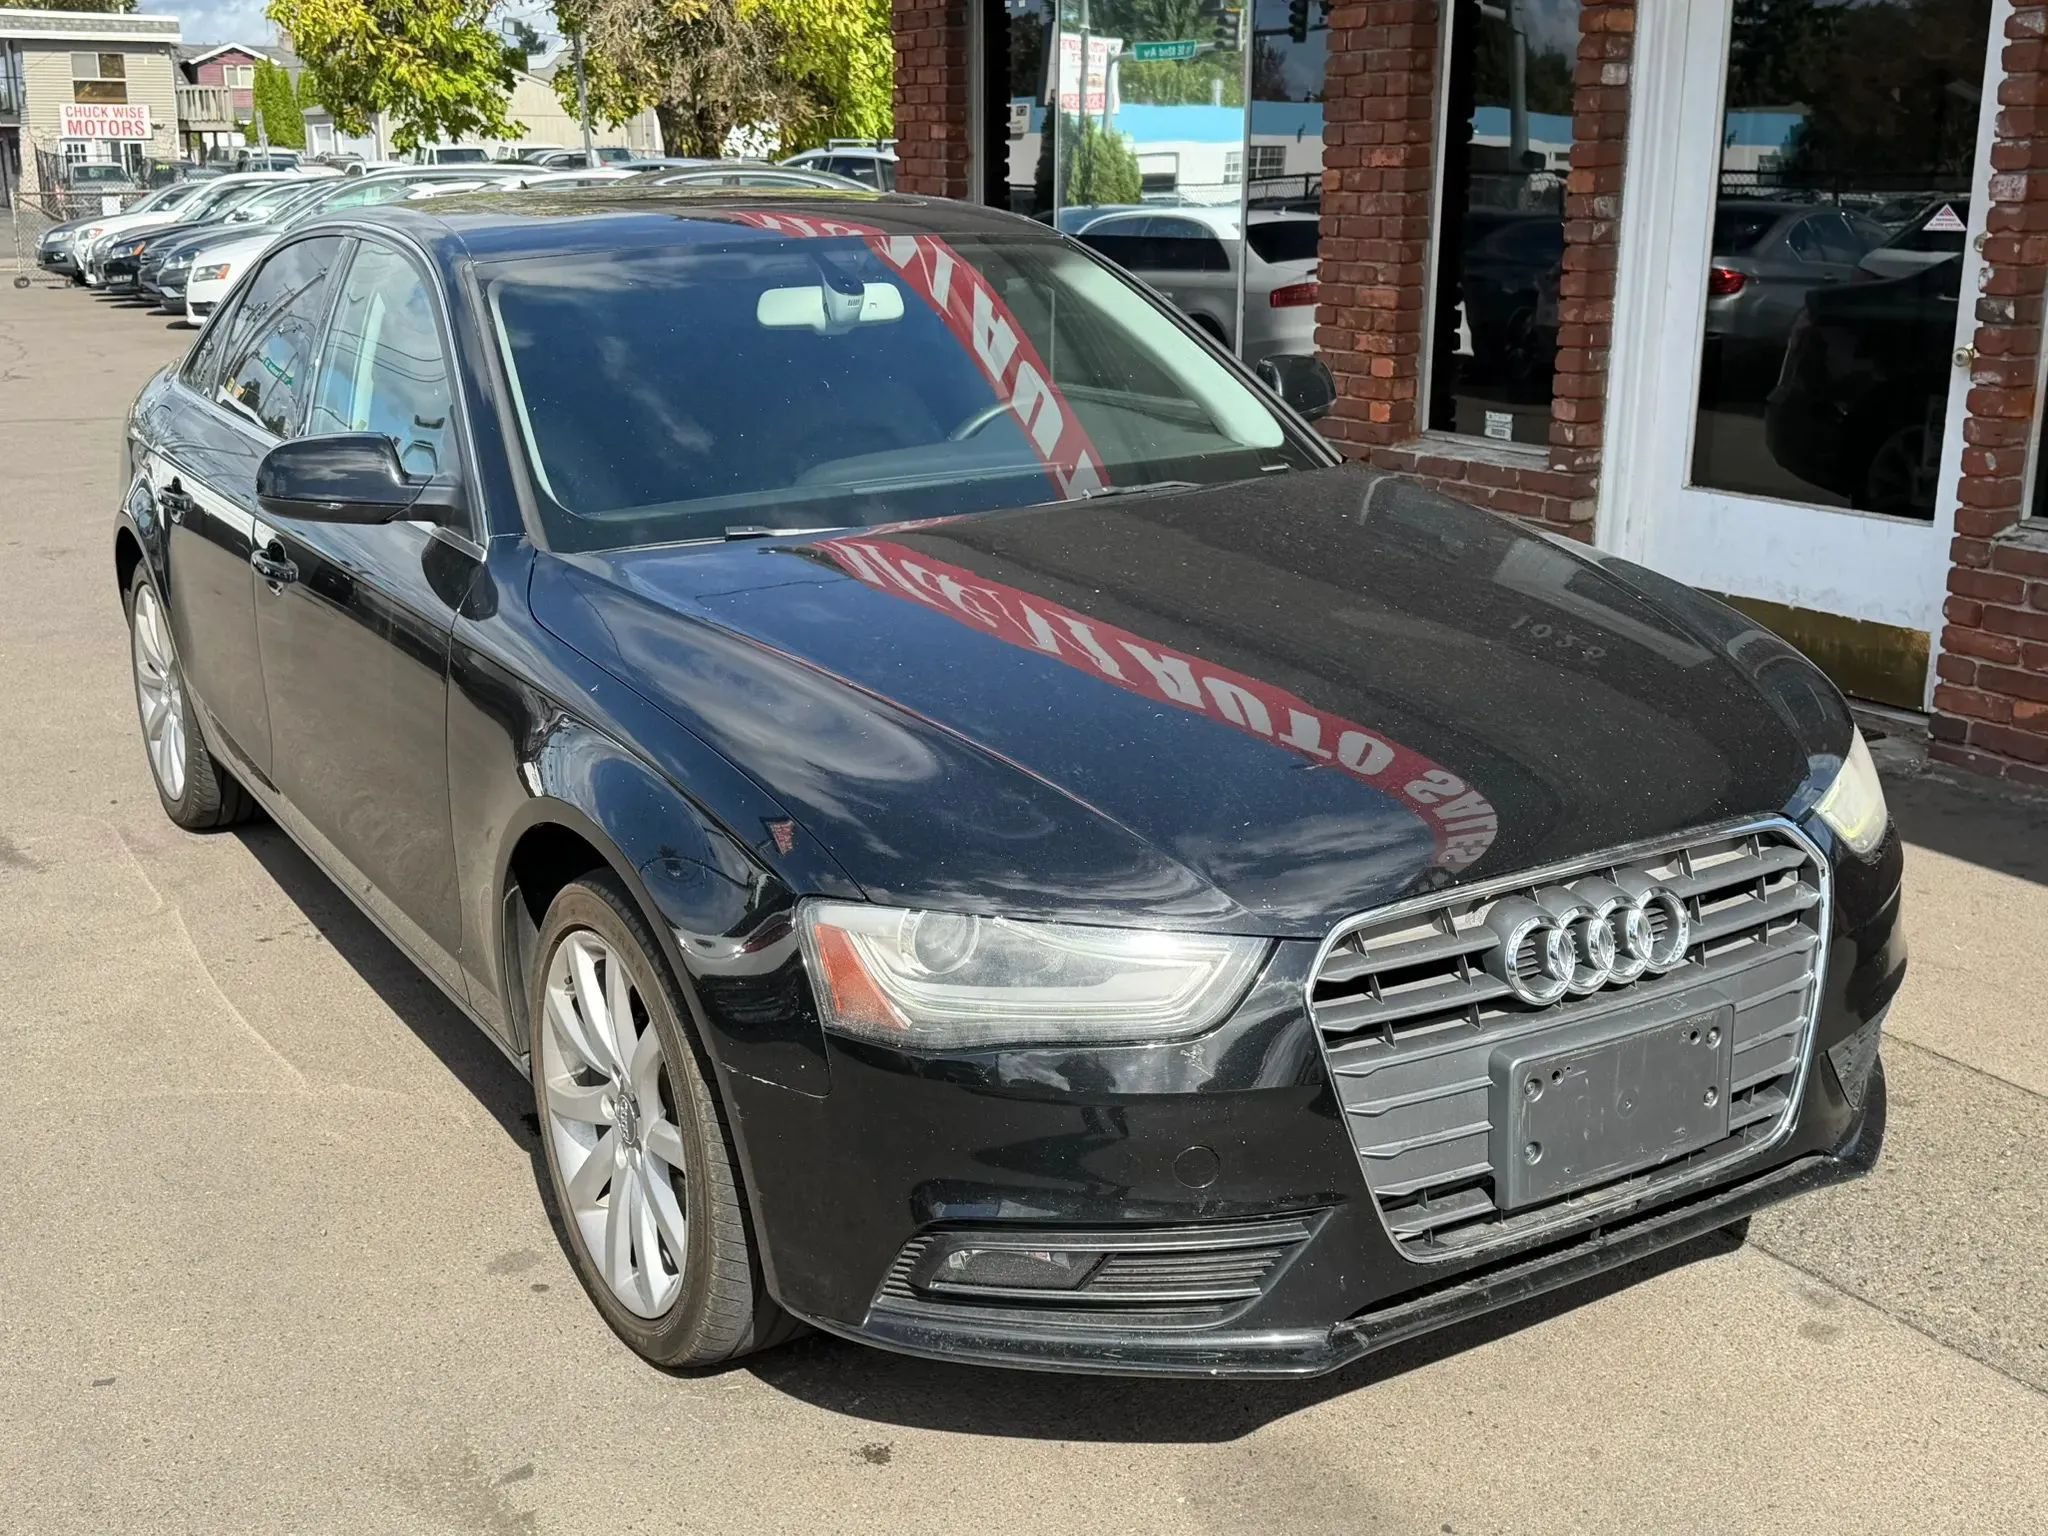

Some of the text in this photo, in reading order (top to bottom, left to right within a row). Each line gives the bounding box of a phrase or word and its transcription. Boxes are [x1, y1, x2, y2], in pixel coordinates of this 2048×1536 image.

[66, 106, 145, 118] CHUCK WISE
[67, 120, 145, 136] MOTORS
